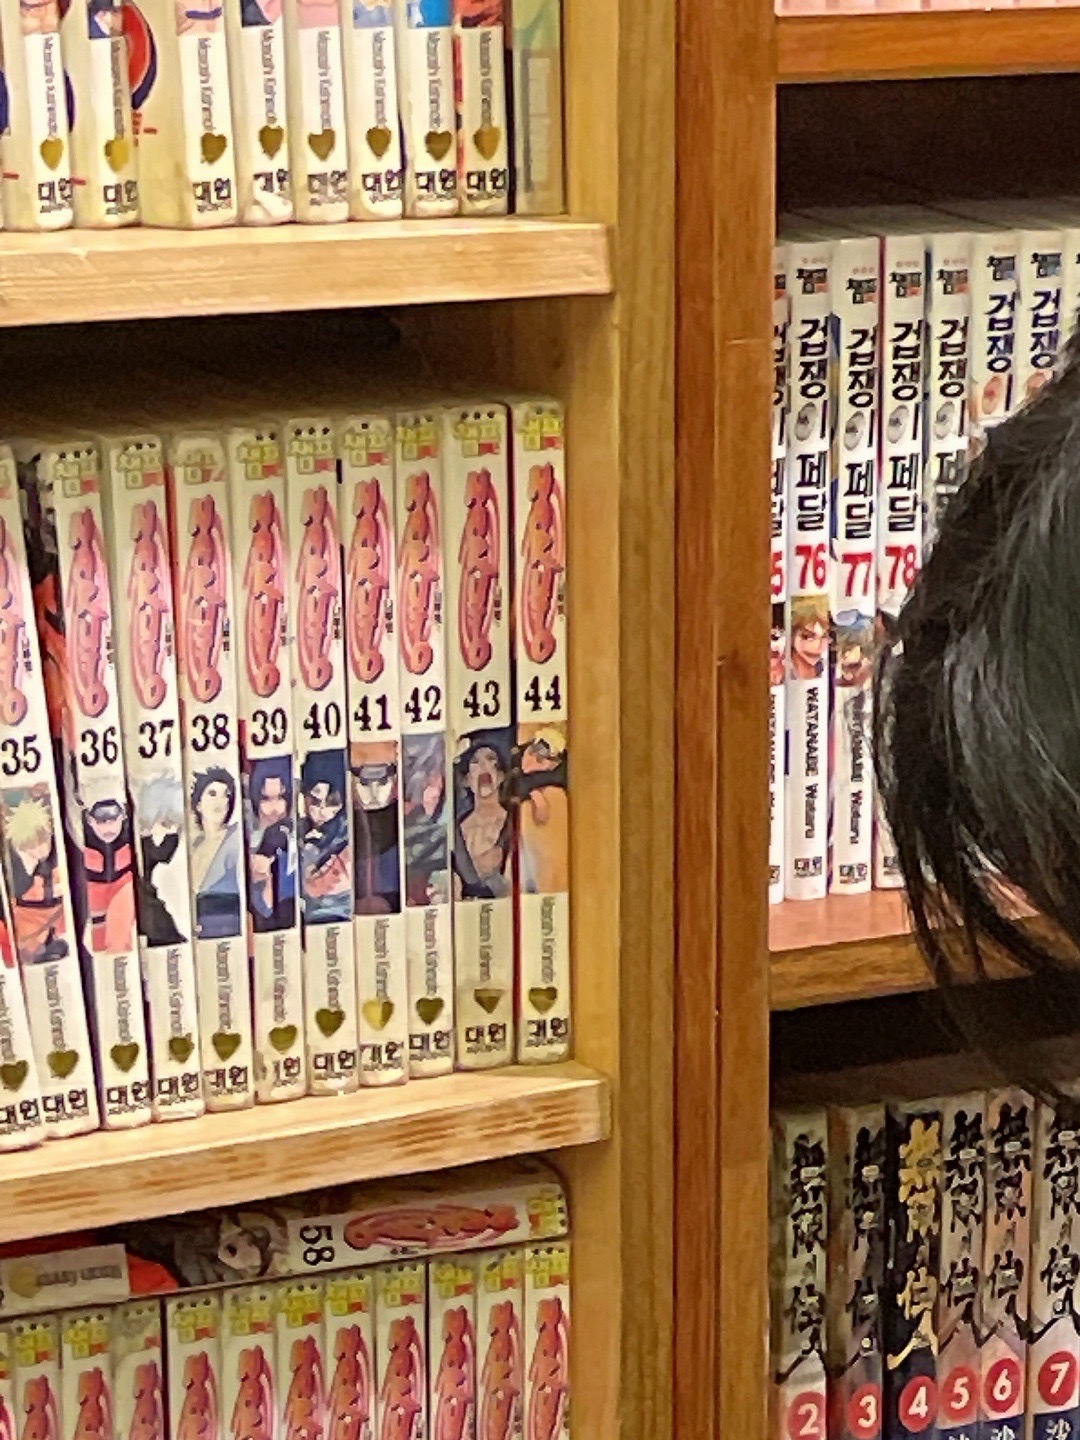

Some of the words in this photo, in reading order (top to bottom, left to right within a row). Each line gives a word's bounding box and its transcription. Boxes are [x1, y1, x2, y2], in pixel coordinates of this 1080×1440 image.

[467, 168, 508, 190] 대원
[982, 292, 1017, 414] 겁쟁이
[794, 319, 829, 441] 겁쟁이
[844, 325, 877, 451] 겁쟁이
[887, 320, 923, 444] 겁쟁이
[934, 316, 969, 439] 겁쟁이
[796, 452, 828, 530] 페달
[844, 459, 874, 538] 페달
[887, 454, 919, 531] 페달
[795, 544, 827, 589] 76
[842, 553, 874, 597] 77
[884, 546, 917, 589] 78
[404, 686, 442, 723] 42
[463, 680, 501, 717] 43
[524, 675, 562, 711] 44
[251, 708, 288, 746] 39
[303, 703, 341, 739] 40
[353, 694, 392, 732] 41
[805, 687, 820, 777] WATANABE
[80, 728, 118, 767] 36
[139, 721, 175, 759] 37
[191, 714, 230, 751] 38
[1, 735, 41, 775] 35
[466, 1023, 507, 1043] 대원
[314, 1050, 356, 1070] 대원
[42, 1089, 88, 1112] 대원
[106, 1082, 150, 1105] 대원
[157, 1073, 199, 1095] 대원
[299, 1224, 335, 1266] 58
[949, 1380, 971, 1412] 5
[992, 1371, 1013, 1400] 6
[1049, 1361, 1069, 1395] 7
[857, 1399, 879, 1428] 3
[907, 1389, 930, 1420] 4
